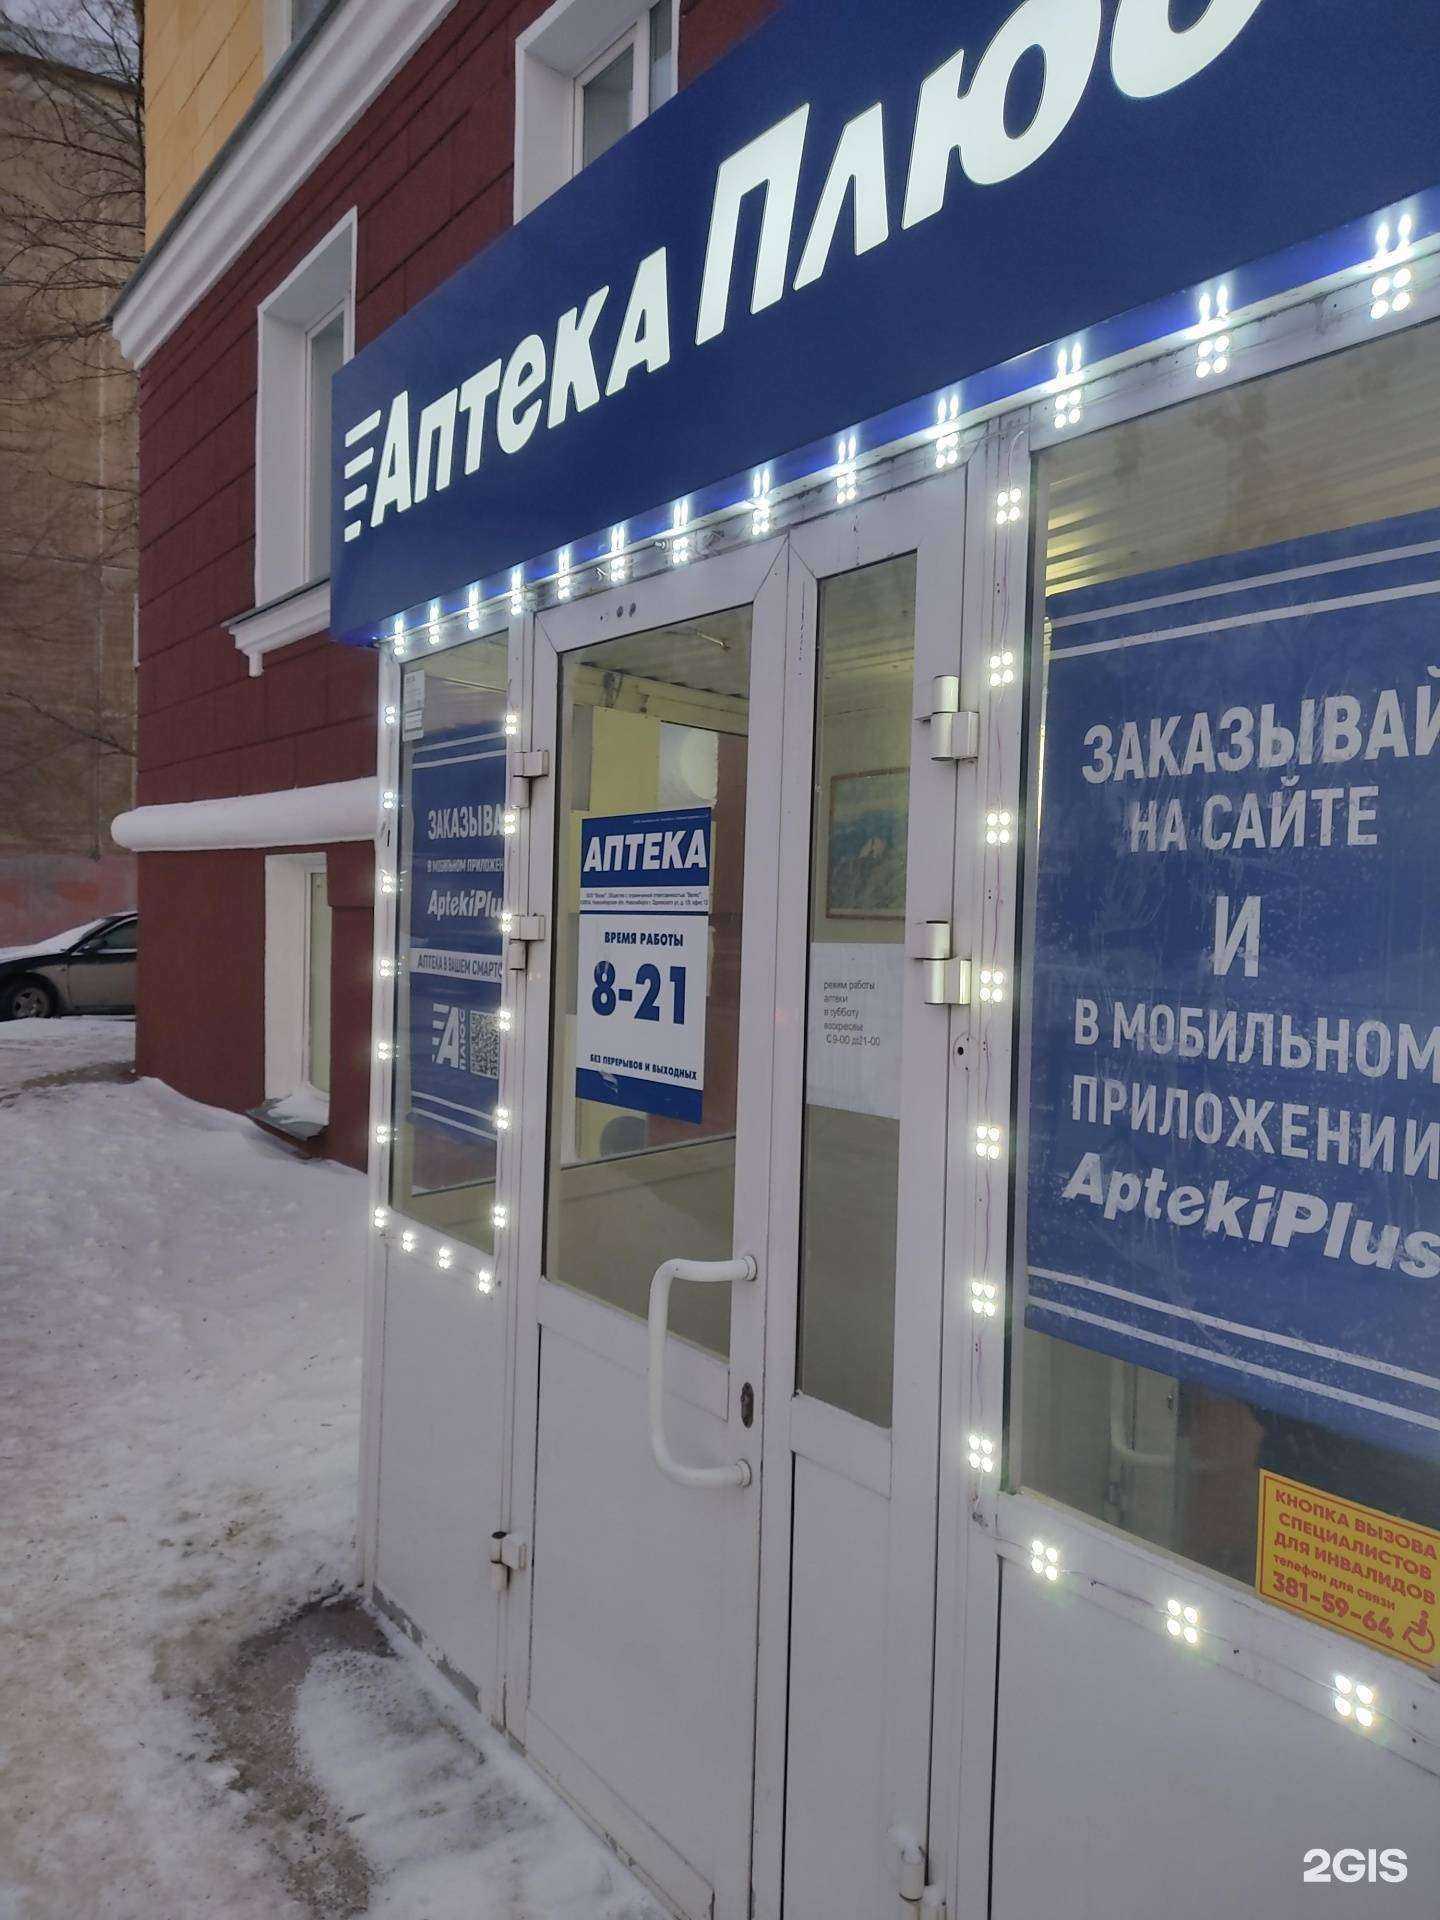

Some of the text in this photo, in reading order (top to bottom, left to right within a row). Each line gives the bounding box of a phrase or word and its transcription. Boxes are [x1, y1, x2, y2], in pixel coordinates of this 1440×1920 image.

[1130, 775, 1380, 853] НА САЙТЕ
[582, 829, 707, 873] АПТЕКА
[604, 931, 684, 946] ВРЕМЯ РАБОТЫ
[1213, 895, 1261, 978] И
[591, 960, 687, 1025] 8-21
[602, 1056, 642, 1071] ПЕРЕРЫВОВ
[645, 1063, 650, 1072] И
[652, 1064, 697, 1080] ВЫХОДНЫХ
[1075, 998, 1440, 1085] В МОБИЛЬНОМ
[1071, 1074, 1440, 1181] ПРИЛОЖЕНИИ
[1062, 1150, 1440, 1279] AptekiPlus
[1276, 1490, 1437, 1560] КНОПКА ВЫЗОВА
[1278, 1513, 1432, 1580] СПЕЦИАЛИСТОВ
[1274, 1532, 1435, 1605] ДЛЯ ИНВАЛИДОВ
[1274, 1554, 1326, 1583] телефон
[1273, 1570, 1394, 1638] 381-59-64
